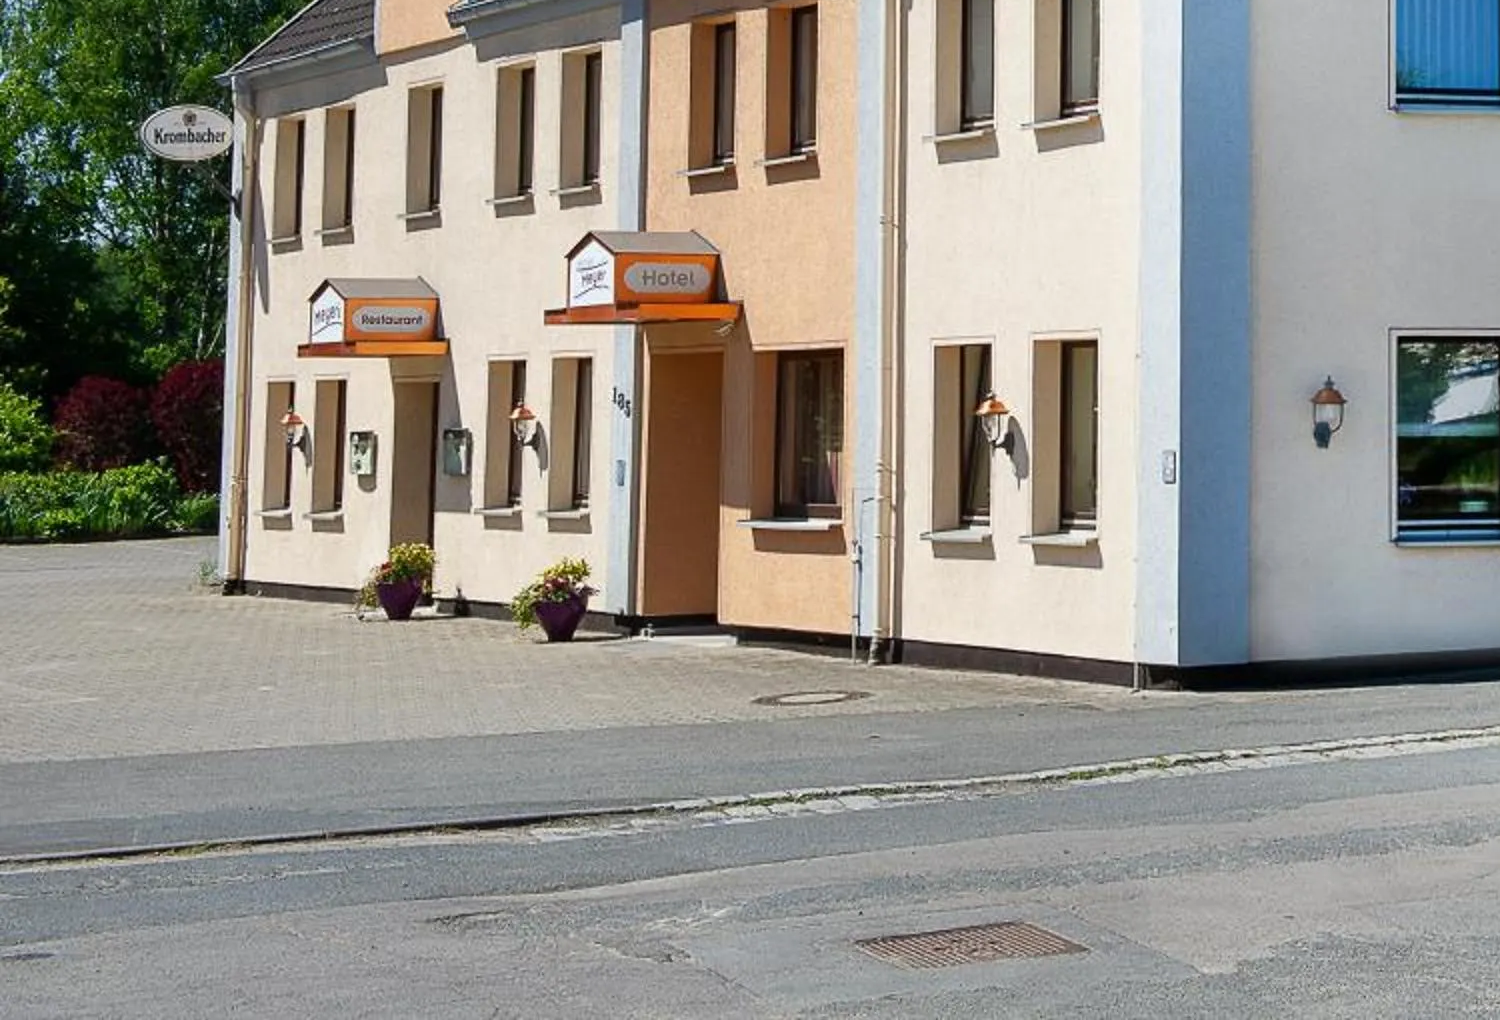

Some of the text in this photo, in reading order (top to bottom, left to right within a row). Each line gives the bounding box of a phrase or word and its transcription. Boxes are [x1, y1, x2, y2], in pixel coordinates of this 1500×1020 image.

[153, 127, 226, 145] Krombacher
[641, 269, 696, 287] Hotel
[360, 314, 423, 325] Restaurant
